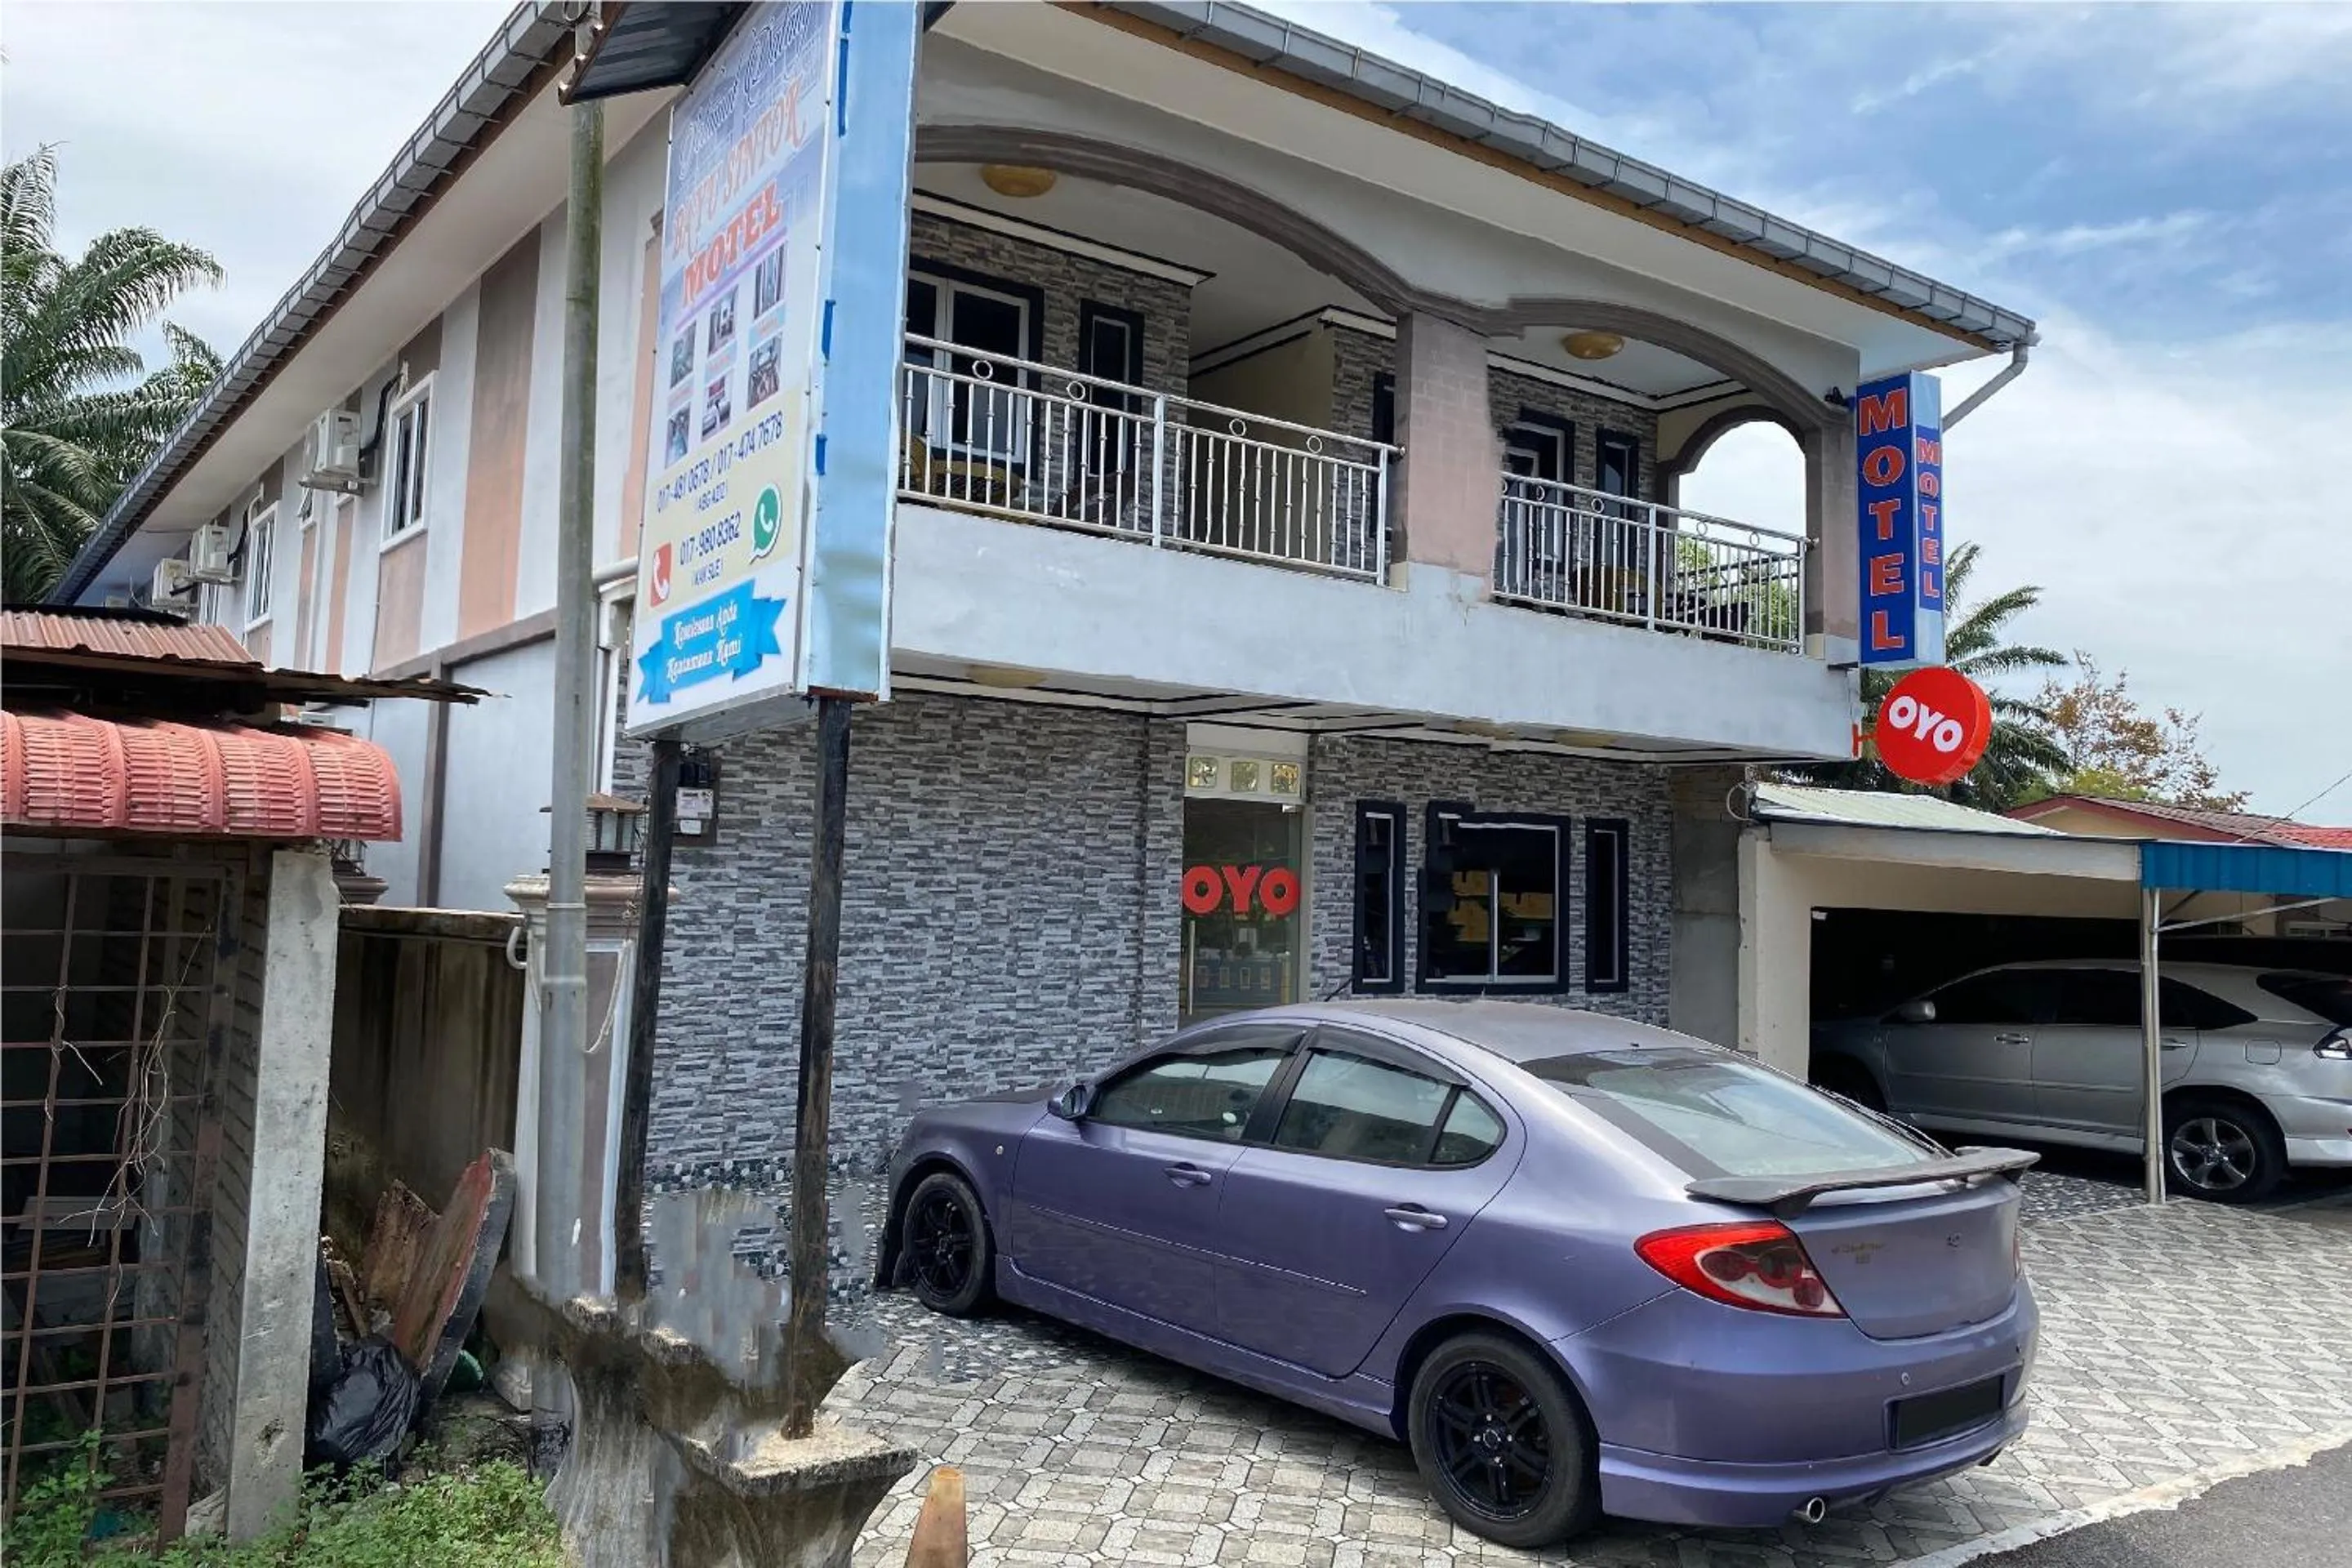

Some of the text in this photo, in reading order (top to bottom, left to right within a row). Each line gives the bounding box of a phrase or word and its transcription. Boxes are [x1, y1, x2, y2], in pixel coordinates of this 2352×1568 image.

[683, 179, 782, 305] MOTEL
[1859, 387, 1907, 651] MOTEL
[1916, 437, 1941, 599] MOTEL
[1888, 695, 1962, 753] OYO
[1182, 865, 1300, 916] OYO
